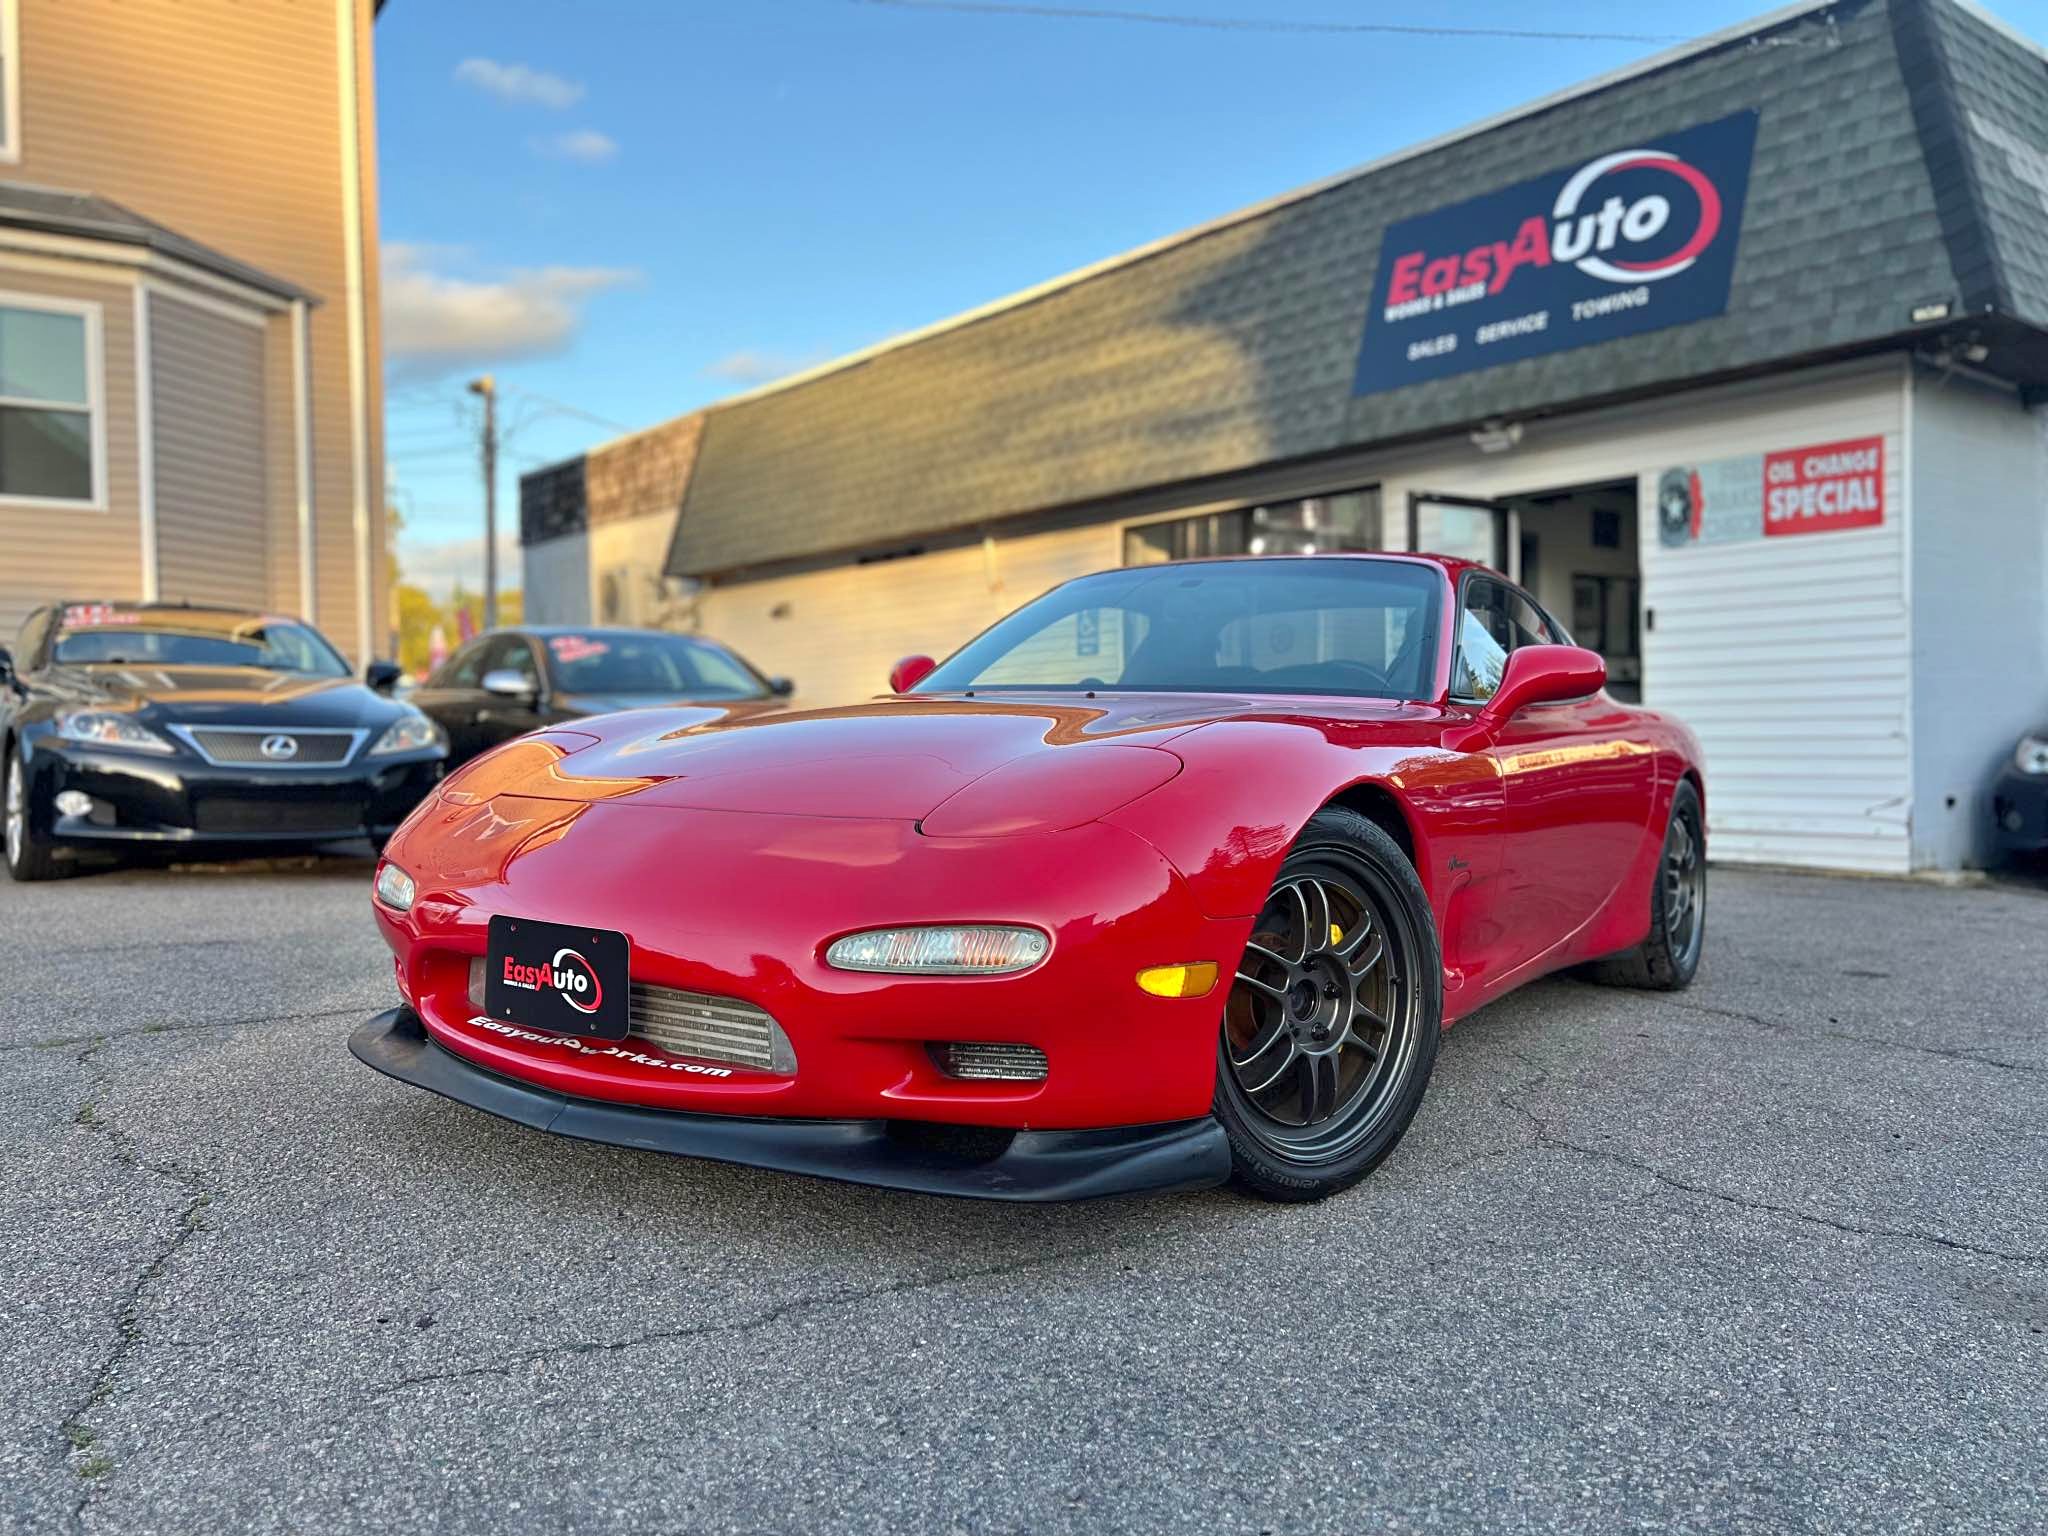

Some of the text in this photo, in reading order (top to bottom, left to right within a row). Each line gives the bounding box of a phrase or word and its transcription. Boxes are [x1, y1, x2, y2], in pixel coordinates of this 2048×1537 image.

[1407, 286, 1649, 361] SALES SERVICE TOWING
[1768, 447, 1877, 484] OIL CHANGE
[1769, 476, 1878, 522] SPECIAL
[503, 956, 588, 993] EasyAuto
